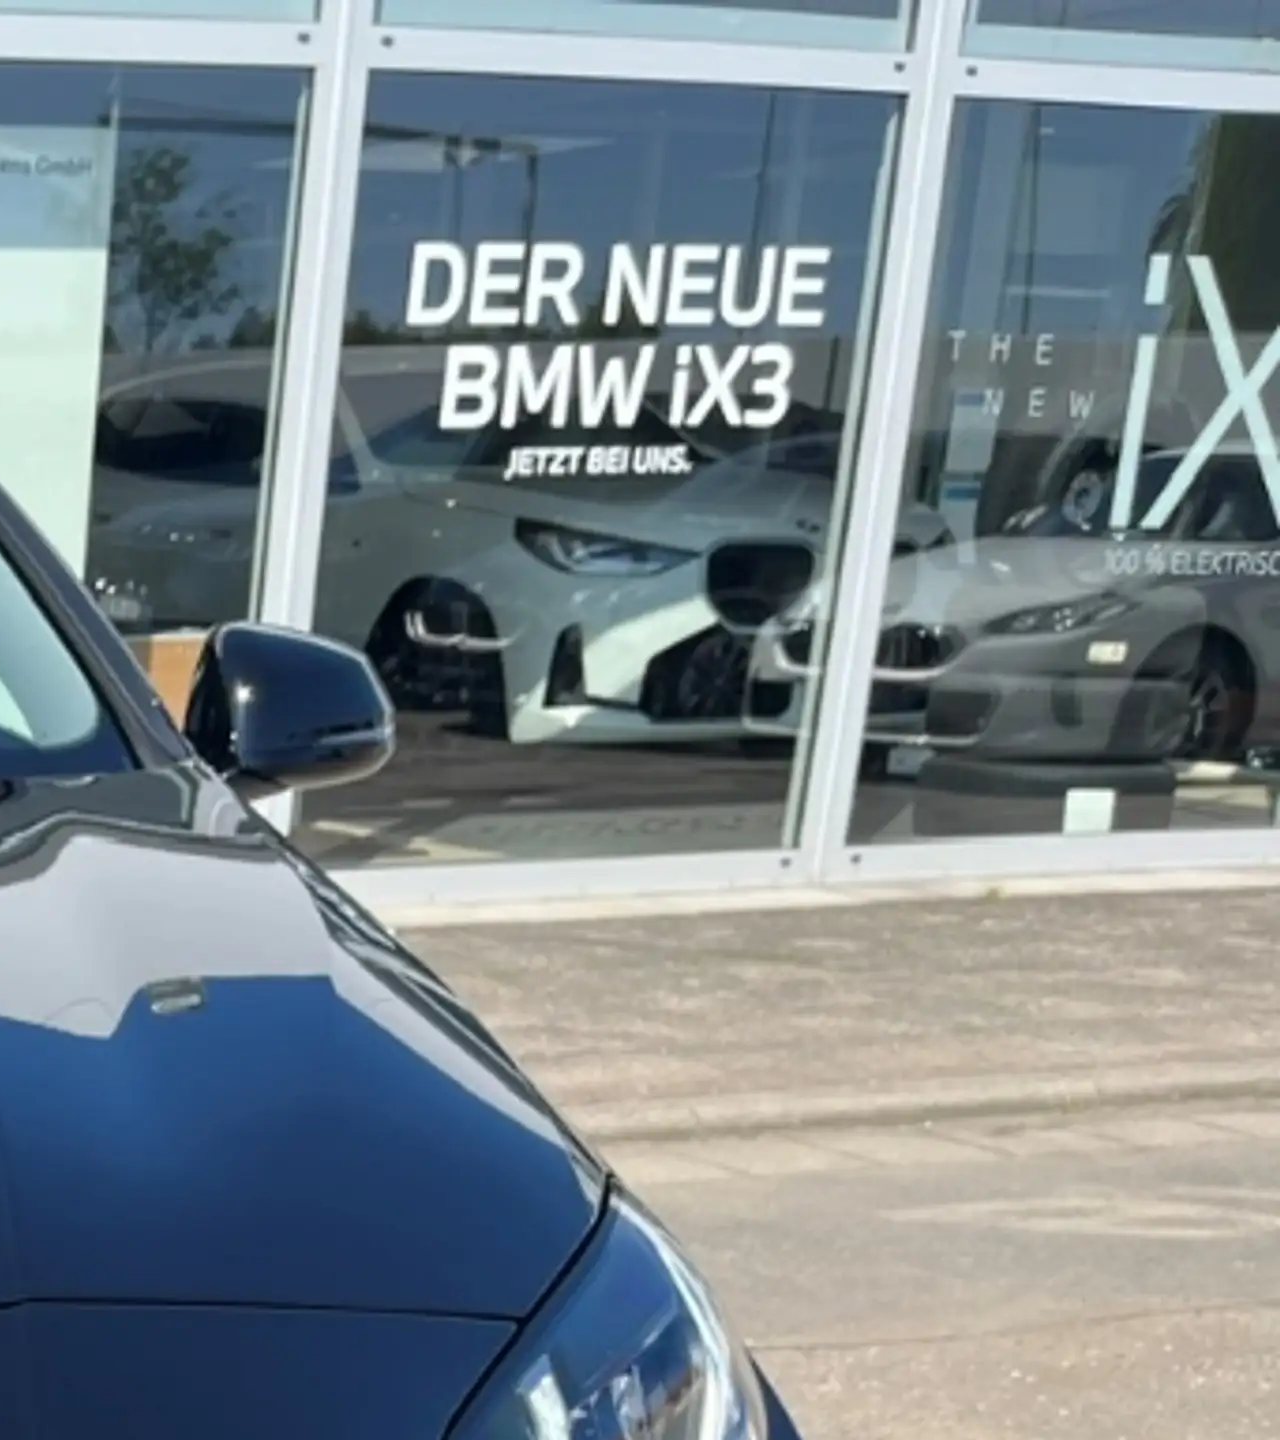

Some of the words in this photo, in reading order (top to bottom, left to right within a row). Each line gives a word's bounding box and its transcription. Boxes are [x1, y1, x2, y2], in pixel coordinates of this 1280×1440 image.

[406, 241, 584, 327] DER
[602, 243, 831, 328] NEUE
[947, 330, 1055, 365] THE
[437, 343, 653, 429] BMW
[668, 342, 794, 428] iX3
[982, 389, 1096, 418] NEW
[503, 445, 586, 481] JETZT
[586, 445, 632, 475] BEI
[632, 443, 694, 475] UNS.
